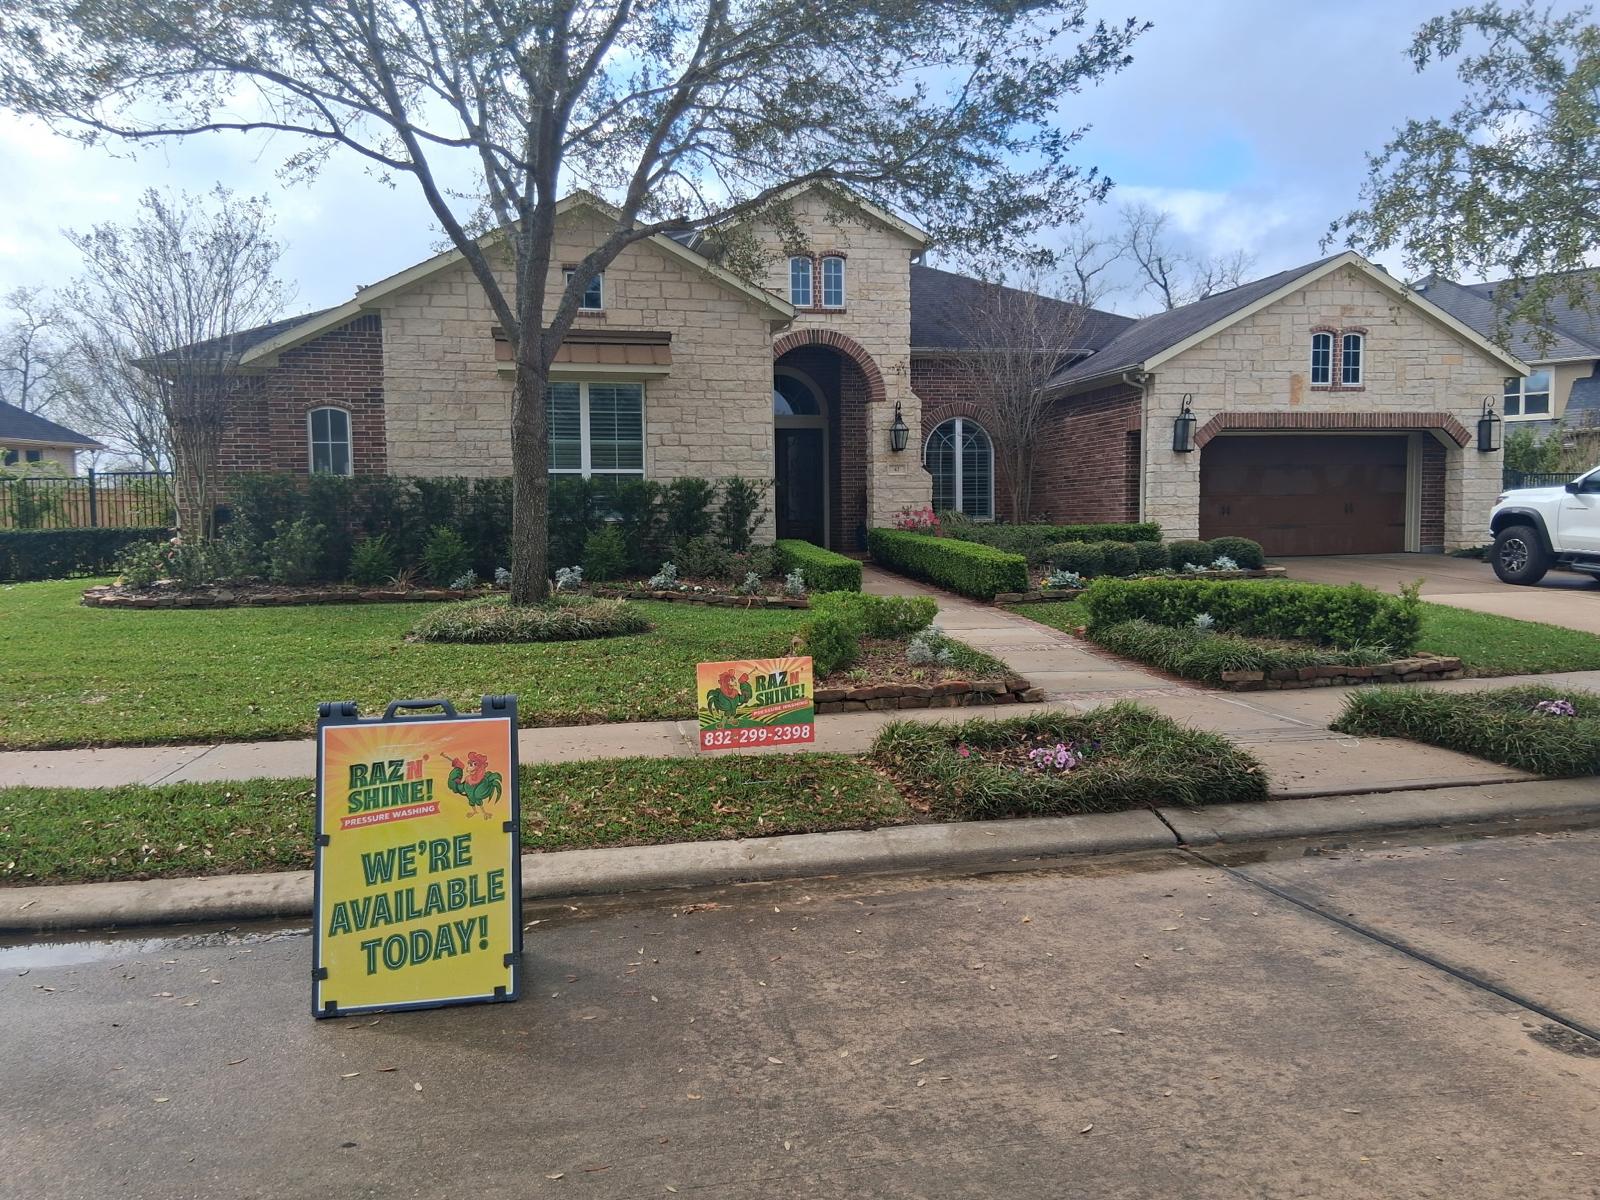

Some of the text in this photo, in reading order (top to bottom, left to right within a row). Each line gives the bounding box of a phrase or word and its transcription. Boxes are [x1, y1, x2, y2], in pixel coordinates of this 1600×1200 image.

[756, 684, 805, 707] SHINE!
[704, 725, 811, 746] 832-299-2398
[348, 778, 433, 814] SHINE!
[344, 805, 435, 827] PRESSURE WASHING
[361, 832, 473, 886] WE'RE
[328, 868, 506, 938] AVAILABLE
[360, 915, 489, 977] TODAY!
